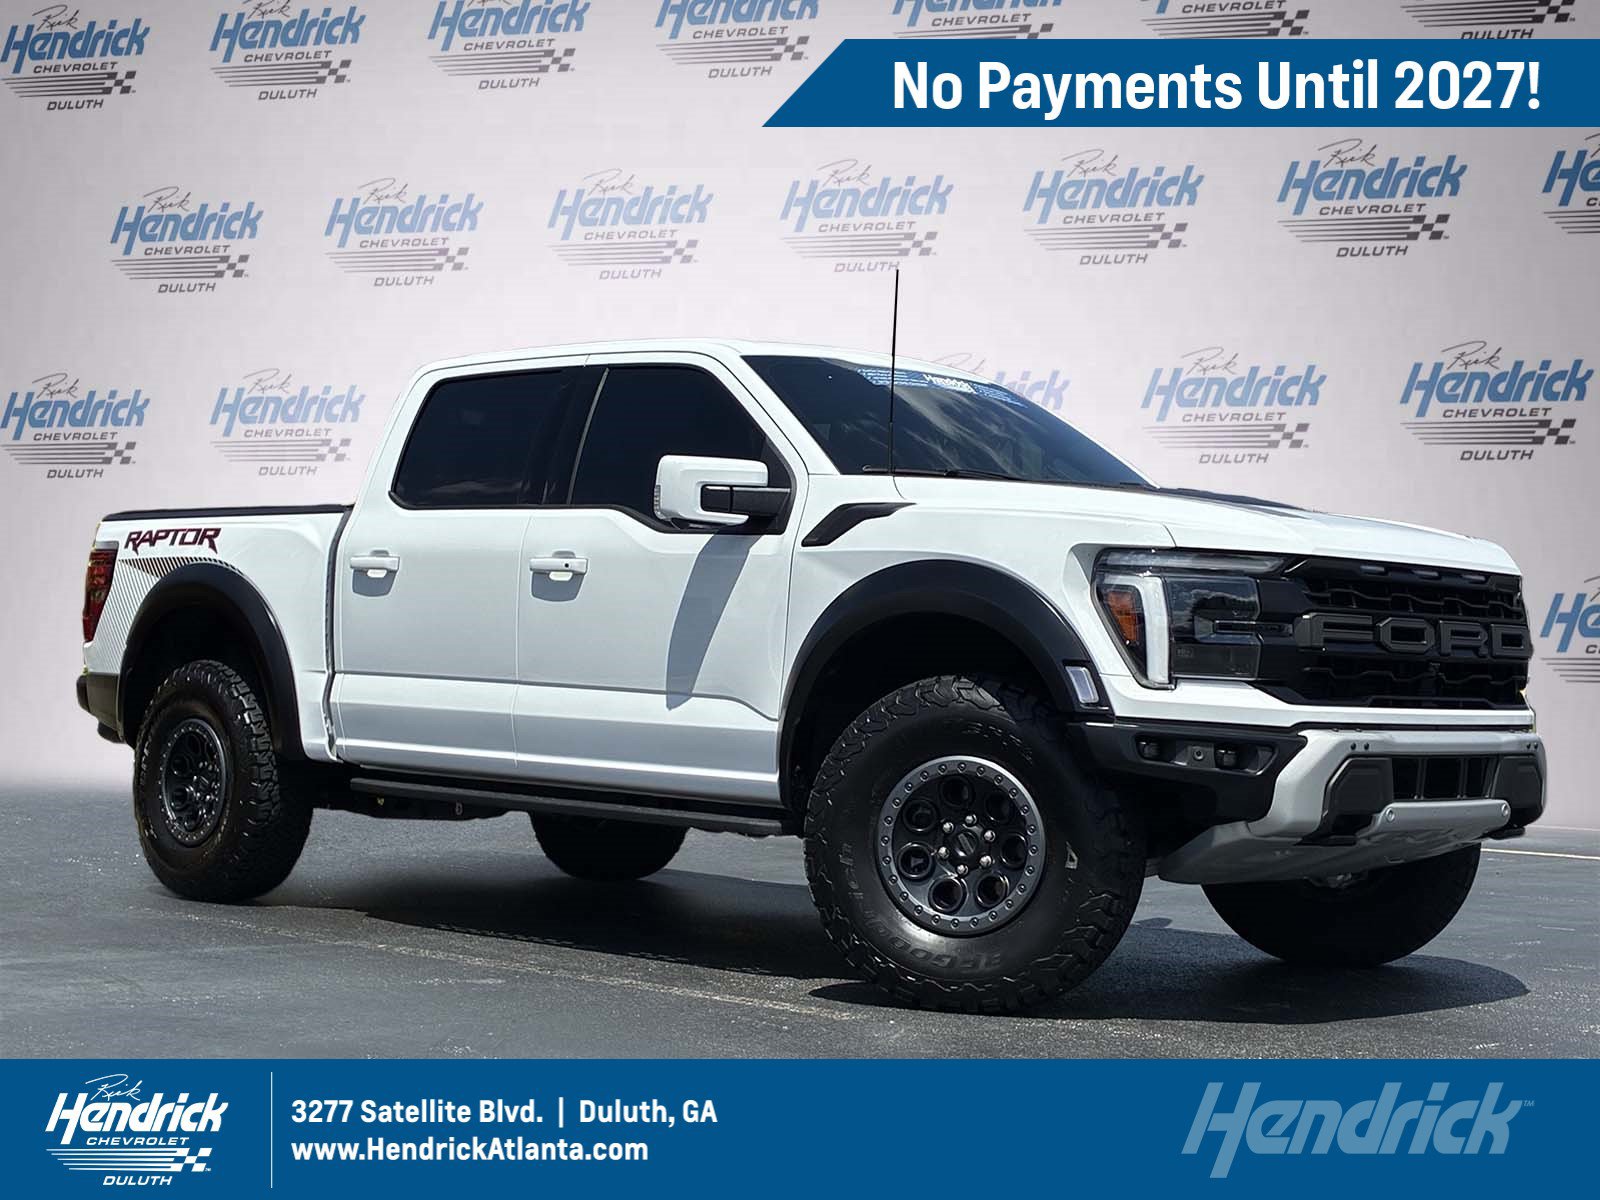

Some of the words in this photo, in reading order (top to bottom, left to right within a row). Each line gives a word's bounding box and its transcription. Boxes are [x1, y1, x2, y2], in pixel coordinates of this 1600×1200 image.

[427, 0, 591, 52] Hendrick
[931, 13, 1032, 27] CHEVROLET
[209, 5, 366, 63] Hendrick
[692, 26, 789, 39] CHEVROLET
[0, 18, 151, 74] Hendrick
[463, 38, 556, 51] CHEVROLET
[244, 50, 332, 63] CHEVROLET
[33, 61, 118, 74] CHEVROLET
[708, 65, 773, 79] DULUTH
[478, 77, 540, 90] DULUTH
[258, 88, 317, 100] DULUTH
[47, 99, 104, 111] DULUTH
[1276, 154, 1468, 217] Hendrick
[1022, 164, 1205, 225] Hendrick
[780, 174, 954, 233] Hendrick
[1319, 203, 1427, 216] CHEVROLET
[547, 183, 715, 241] Hendrick
[1062, 211, 1165, 225] CHEVROLET
[324, 192, 484, 248] Hendrick
[818, 220, 916, 233] CHEVROLET
[110, 201, 264, 256] Hendrick
[584, 229, 678, 241] CHEVROLET
[359, 237, 449, 249] CHEVROLET
[144, 245, 231, 256] CHEVROLET
[1335, 245, 1409, 259] DULUTH
[1079, 253, 1149, 266] DULUTH
[834, 260, 900, 273] DULUTH
[599, 268, 662, 280] DULUTH
[374, 275, 435, 287] DULUTH
[158, 282, 216, 294] DULUTH
[1140, 364, 1328, 422] Hendrick
[1399, 358, 1594, 418] Hendrick
[0, 389, 151, 441] Hendrick
[209, 384, 366, 437] Hendrick
[1181, 411, 1287, 423] CHEVROLET
[1442, 407, 1552, 419] CHEVROLET
[33, 431, 118, 442] CHEVROLET
[243, 427, 333, 439] CHEVROLET
[1198, 453, 1270, 465] DULUTH
[1459, 449, 1534, 462] DULUTH
[46, 467, 104, 479] DULUTH
[258, 465, 318, 477] DULUTH
[124, 527, 222, 554] RAPTOR
[1294, 612, 1534, 659] FORD
